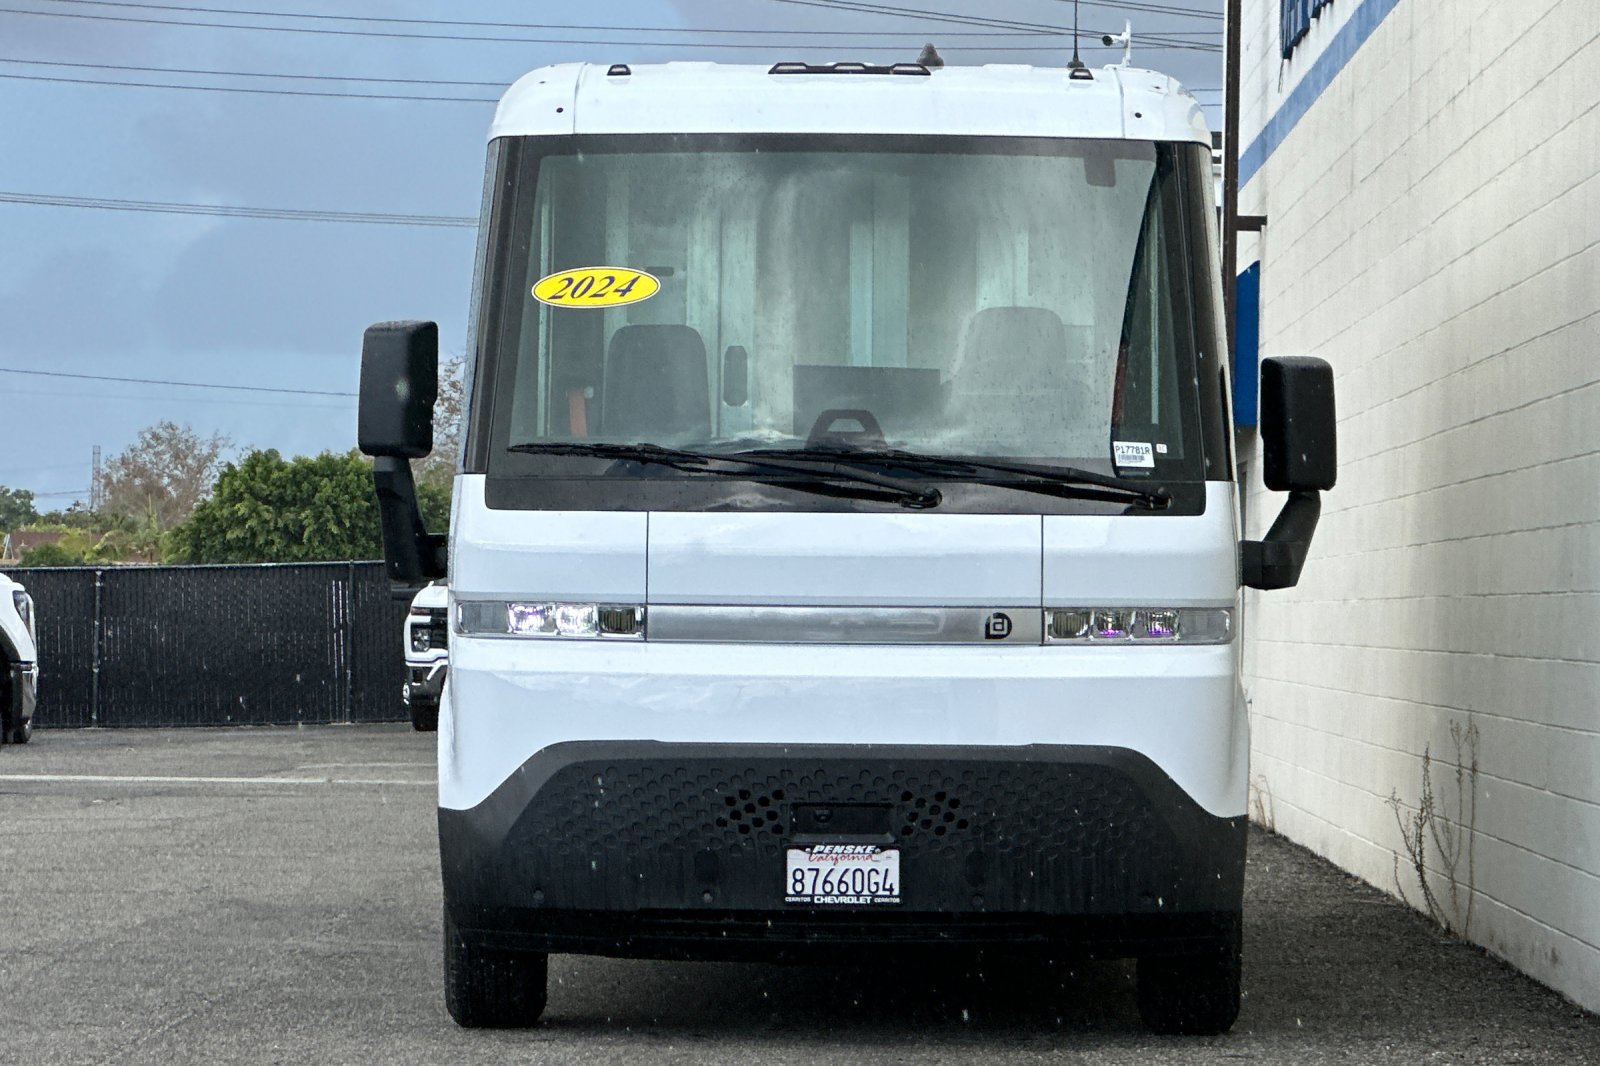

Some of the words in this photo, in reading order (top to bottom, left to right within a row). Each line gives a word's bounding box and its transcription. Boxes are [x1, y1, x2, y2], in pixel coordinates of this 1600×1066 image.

[547, 275, 641, 300] 2024
[813, 844, 876, 854] PENSKE
[792, 867, 895, 895] 87660G4
[814, 895, 872, 904] CHEVROLET
